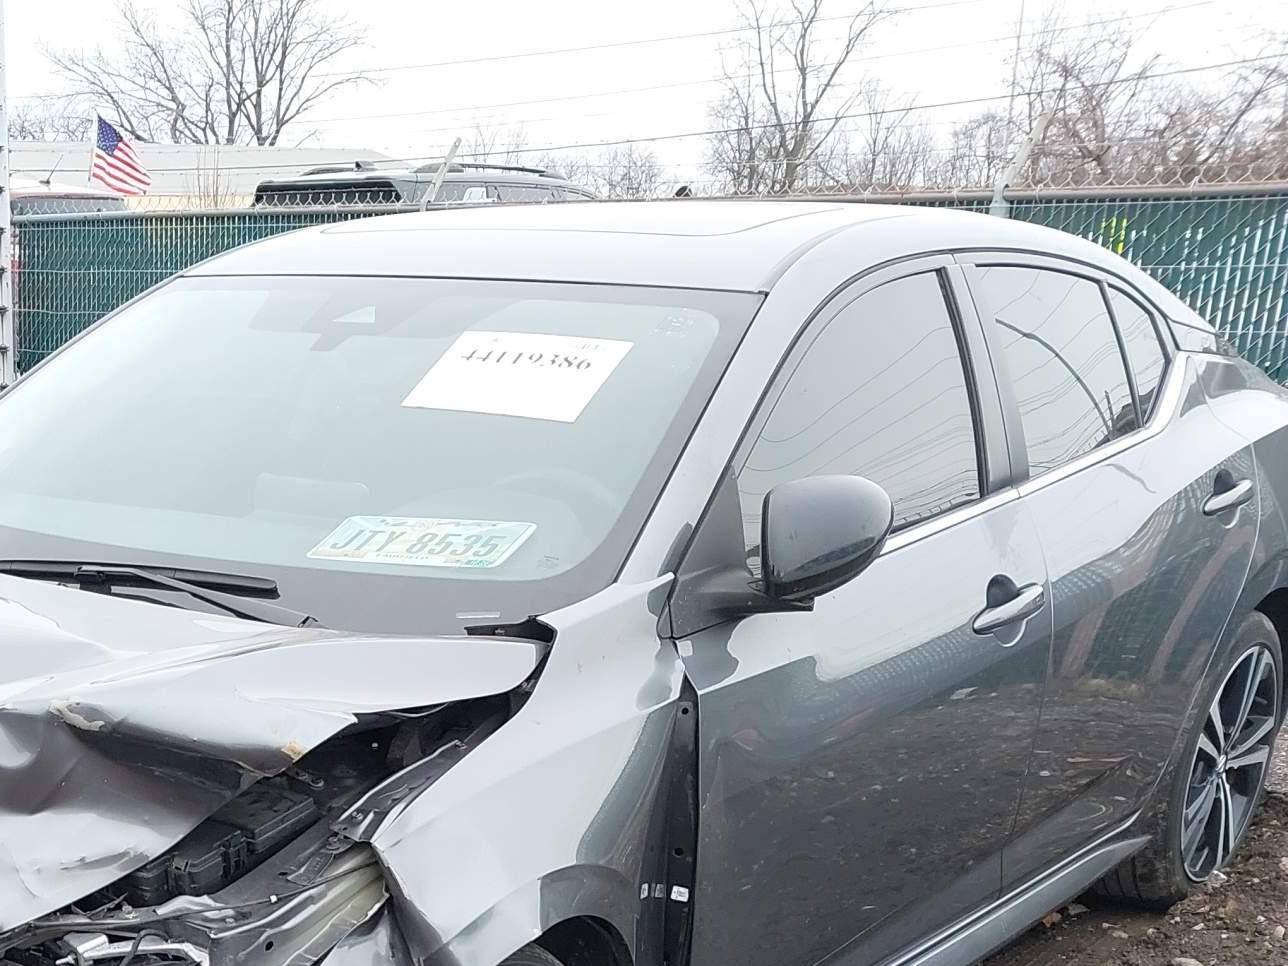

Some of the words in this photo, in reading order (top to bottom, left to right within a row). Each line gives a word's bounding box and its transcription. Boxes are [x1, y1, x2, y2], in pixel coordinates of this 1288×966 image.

[460, 348, 592, 371] 44119386
[329, 529, 407, 553] JTY
[406, 532, 507, 558] 8535
